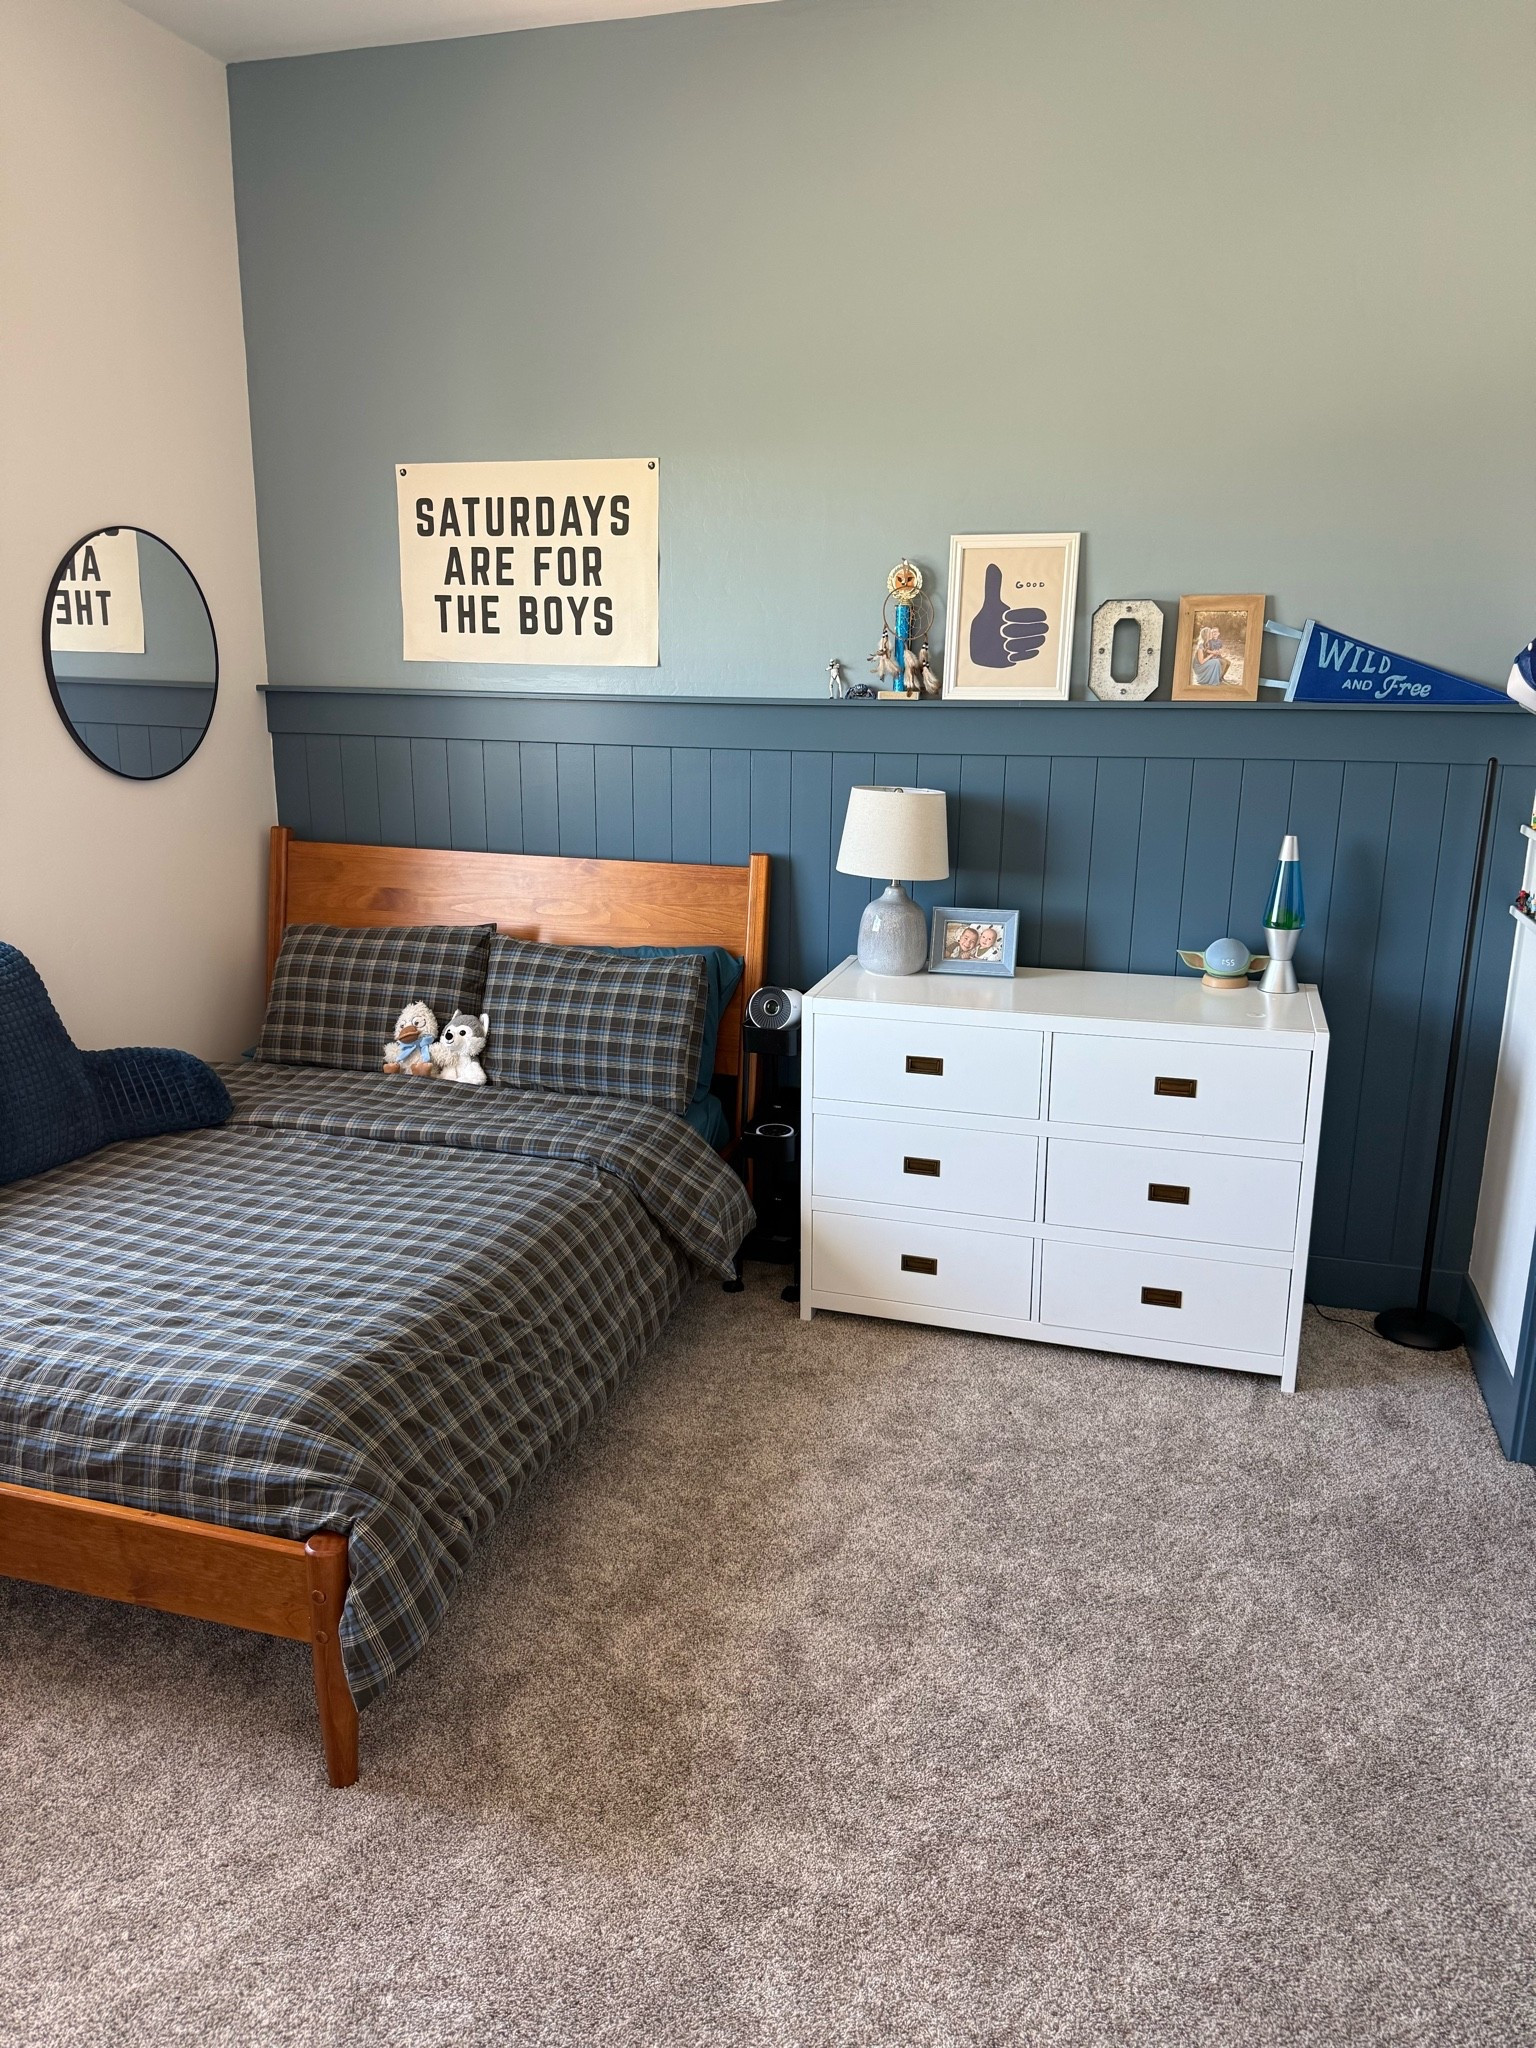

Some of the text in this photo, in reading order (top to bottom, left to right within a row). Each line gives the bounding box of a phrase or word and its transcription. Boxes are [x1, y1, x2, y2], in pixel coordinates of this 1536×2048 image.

[416, 495, 629, 536] SATURDAYS
[444, 547, 601, 586] ARE FOR
[435, 595, 612, 635] THE BOYS
[1318, 632, 1391, 674] WILD
[1341, 674, 1432, 699] AND Free
